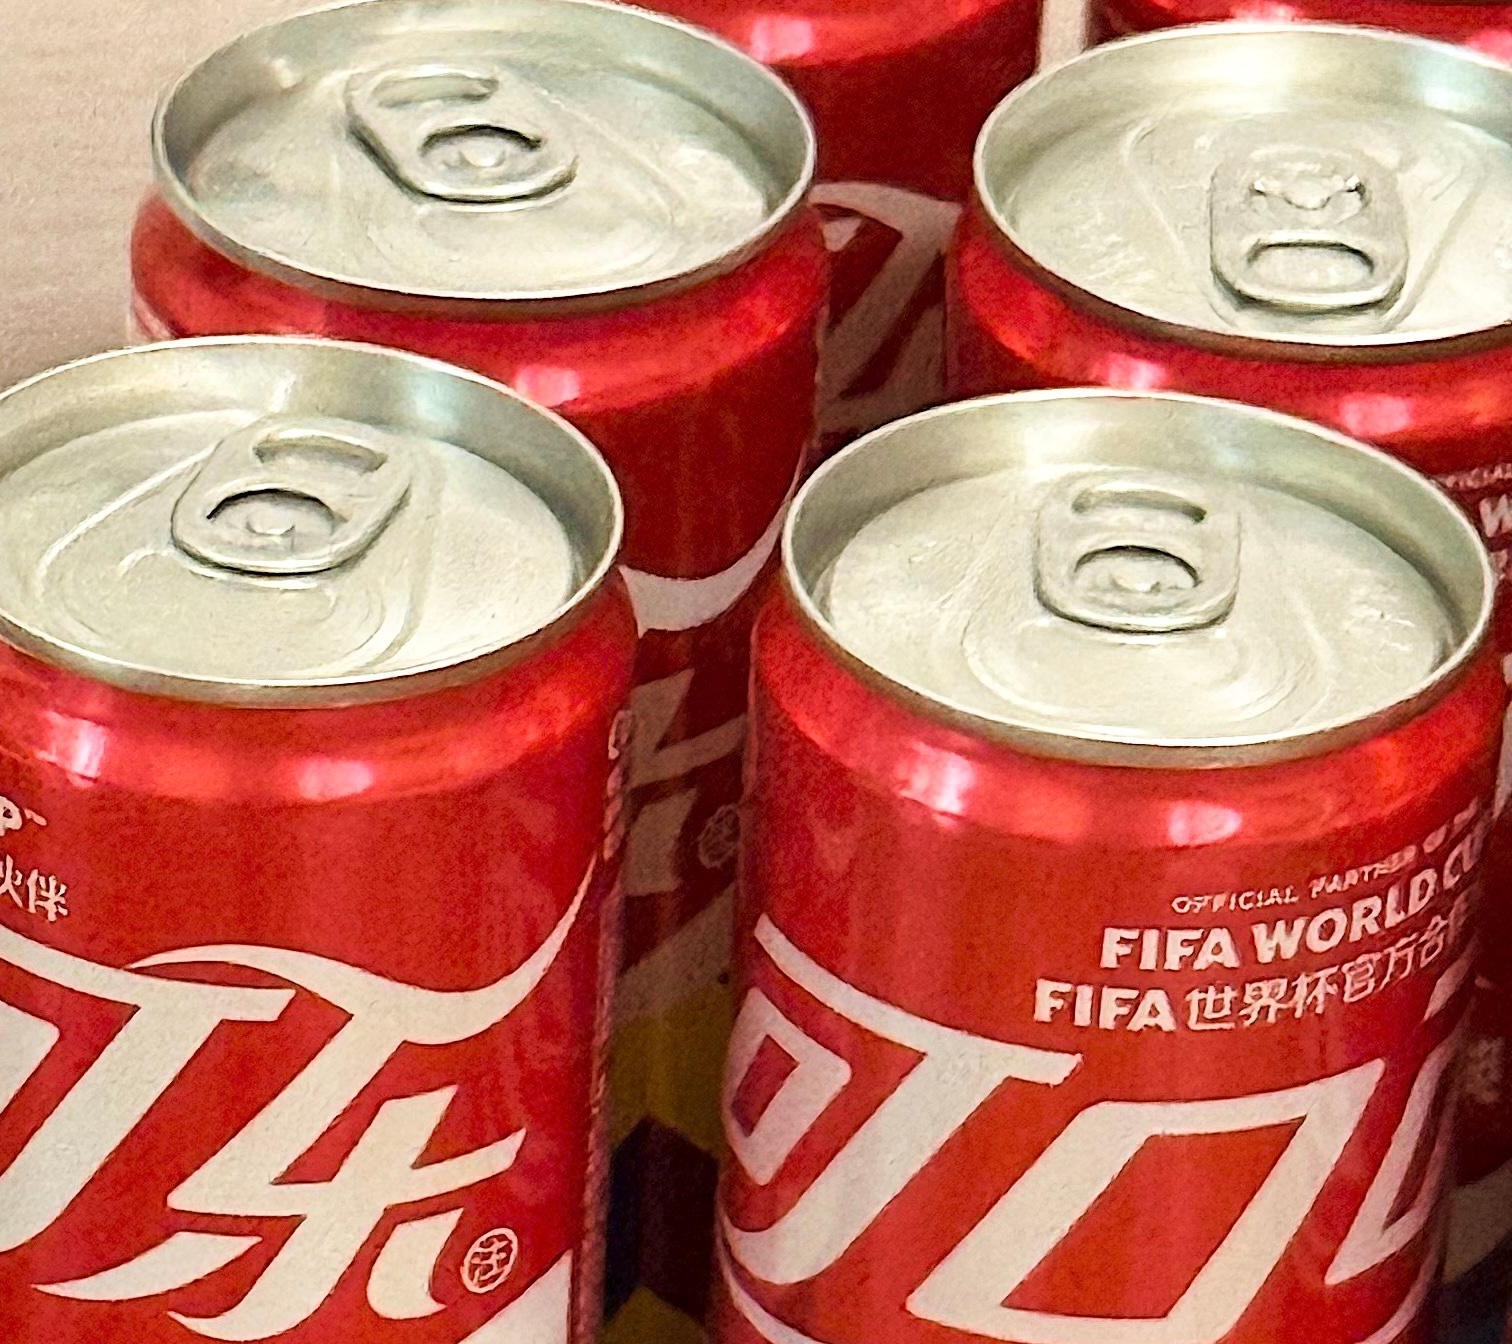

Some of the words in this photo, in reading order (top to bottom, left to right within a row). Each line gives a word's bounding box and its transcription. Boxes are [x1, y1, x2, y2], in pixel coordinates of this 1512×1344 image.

[1099, 926, 1241, 973] FIFA
[1251, 865, 1439, 964] WORLD
[1170, 884, 1299, 915] OFFICIAL
